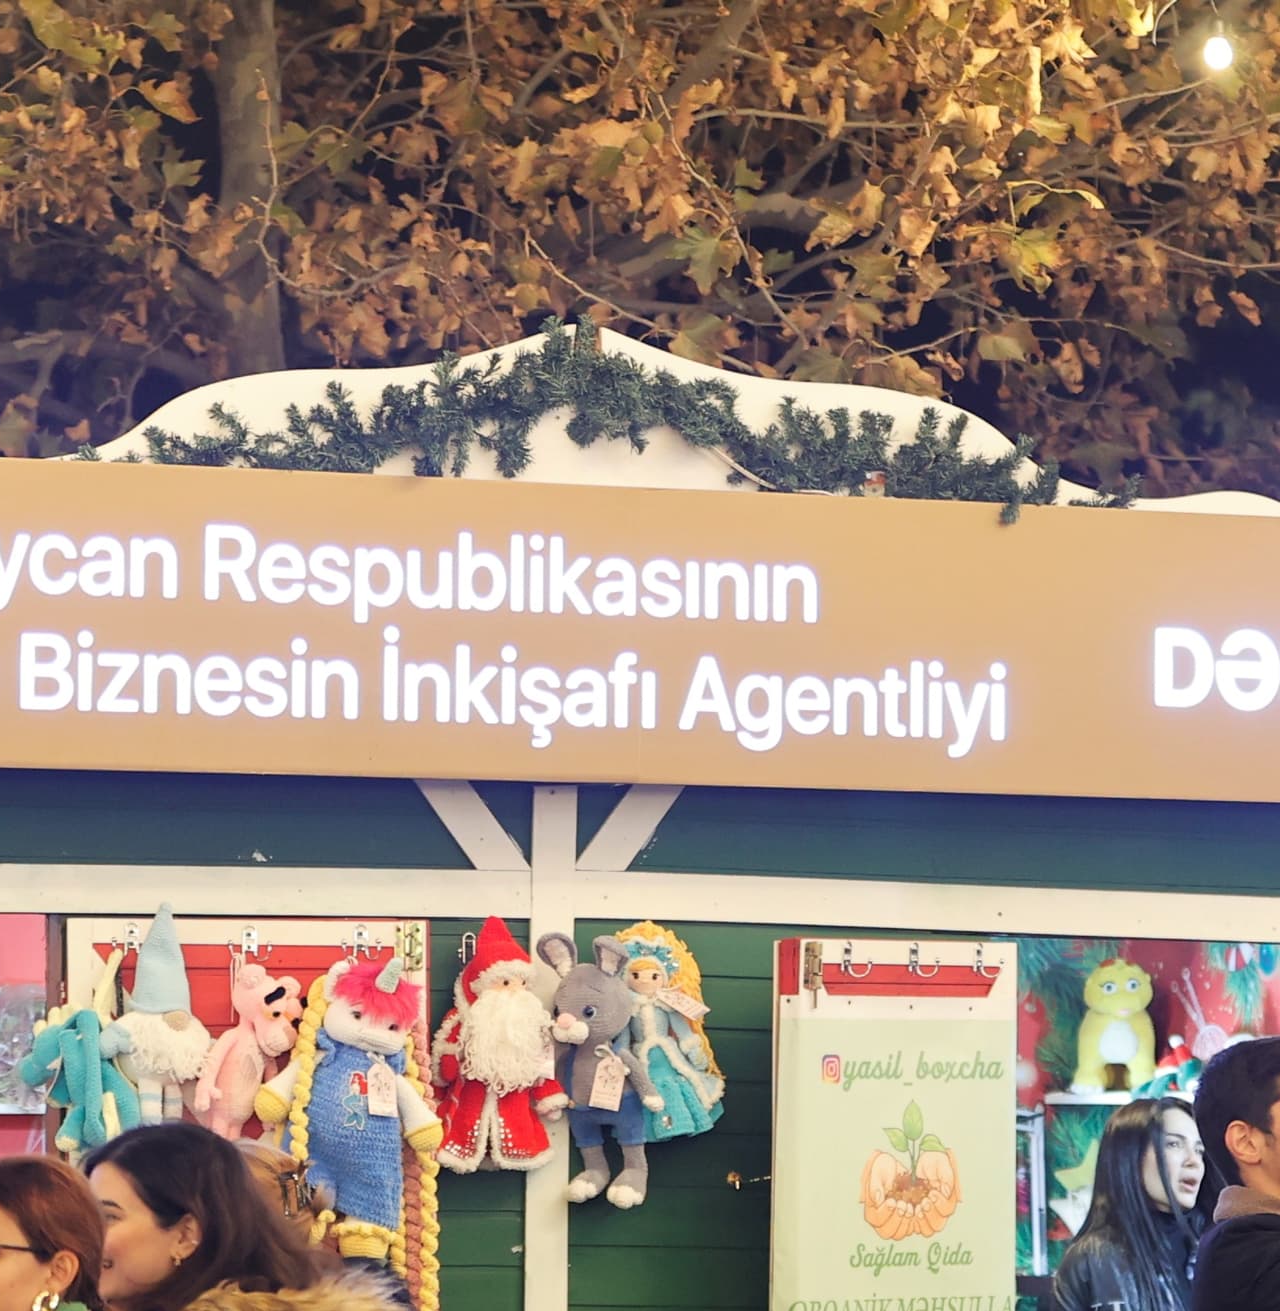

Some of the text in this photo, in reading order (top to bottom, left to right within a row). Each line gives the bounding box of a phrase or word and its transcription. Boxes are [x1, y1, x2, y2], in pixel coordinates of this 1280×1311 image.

[203, 523, 818, 624] Respublikasının
[19, 629, 360, 720] Biznesin
[383, 625, 658, 748] İnkişafı
[678, 655, 1008, 758] Agentliyi
[849, 1242, 973, 1277] Sağlam Qida
